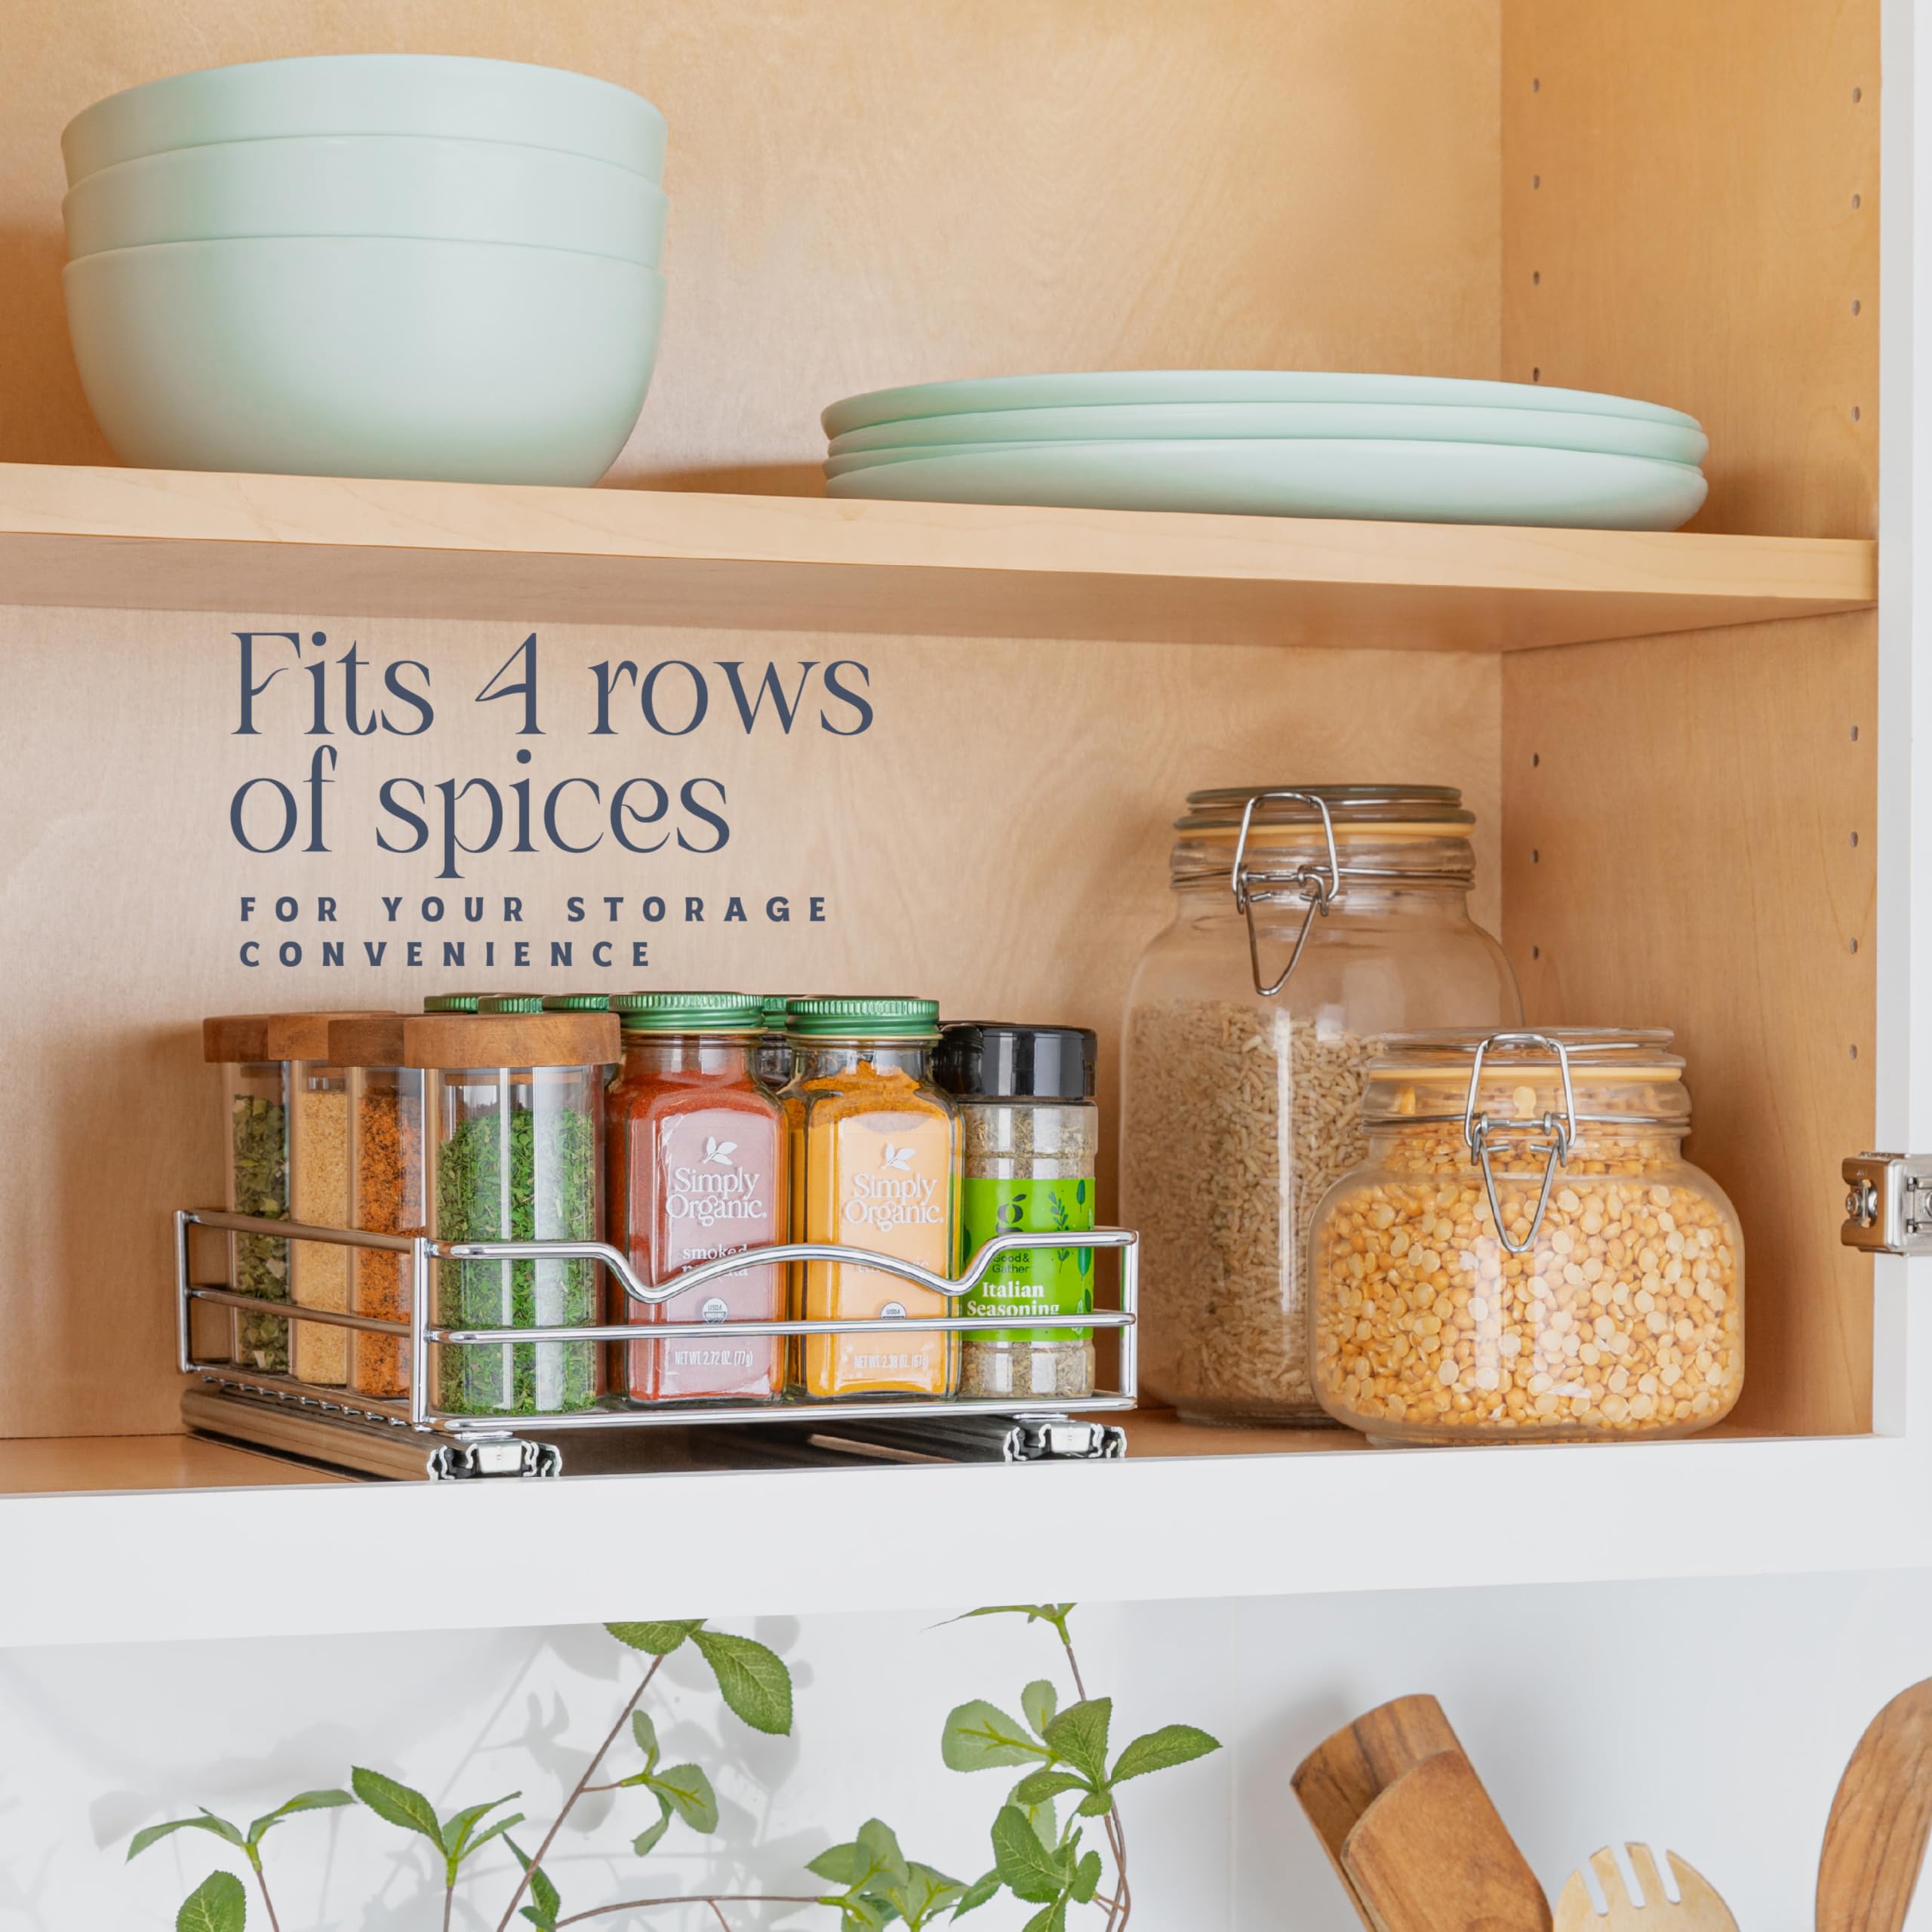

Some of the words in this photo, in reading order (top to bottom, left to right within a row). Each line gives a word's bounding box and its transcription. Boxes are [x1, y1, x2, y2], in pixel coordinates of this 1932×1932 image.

[674, 1166, 760, 1201] Simply
[853, 1172, 937, 1206] Simply
[992, 1263, 1029, 1274] Gather
[982, 1281, 1045, 1298] Italian
[967, 1299, 1060, 1316] Seasoning
[675, 1351, 688, 1365] NET
[734, 1351, 753, 1367] (77g)
